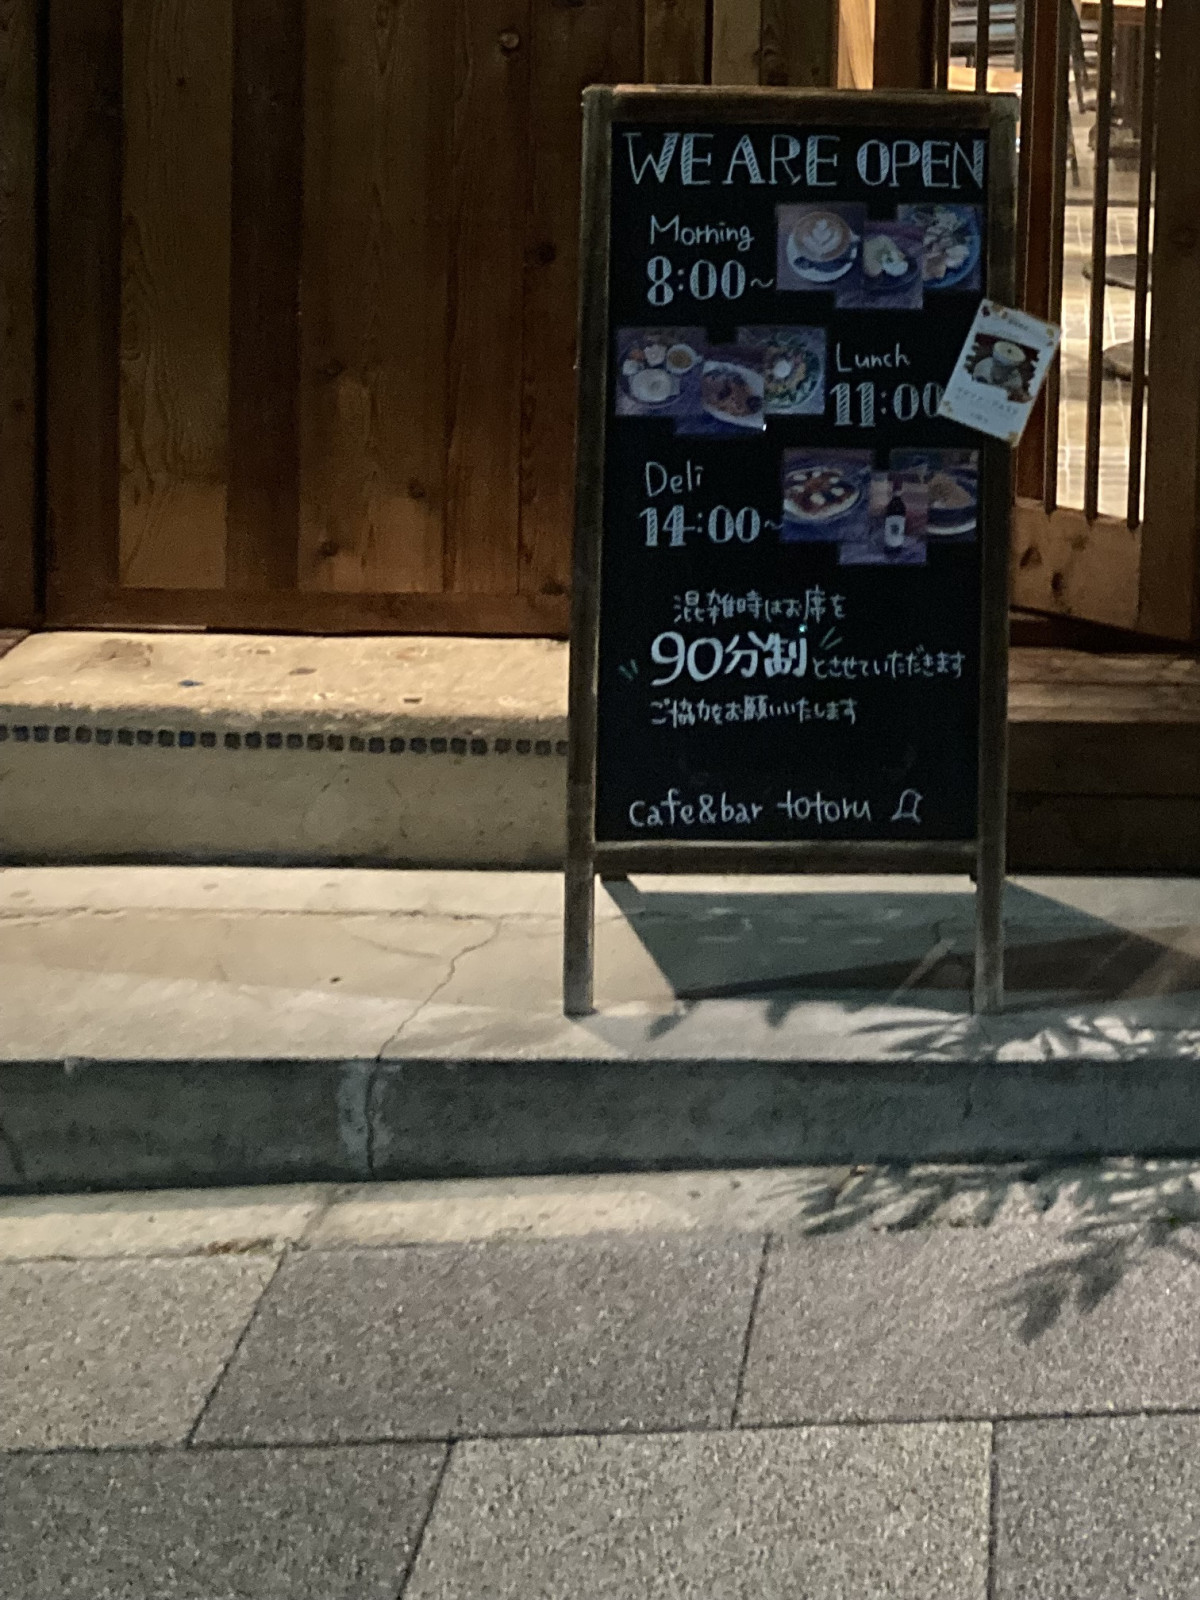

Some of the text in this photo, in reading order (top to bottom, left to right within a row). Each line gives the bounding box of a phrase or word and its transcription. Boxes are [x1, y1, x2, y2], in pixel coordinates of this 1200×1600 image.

[622, 132, 986, 190] WE ARE OPEN
[649, 213, 756, 252] Morning
[834, 342, 911, 374] Lunch
[643, 459, 705, 498] Deli
[776, 790, 872, 824] totoru
